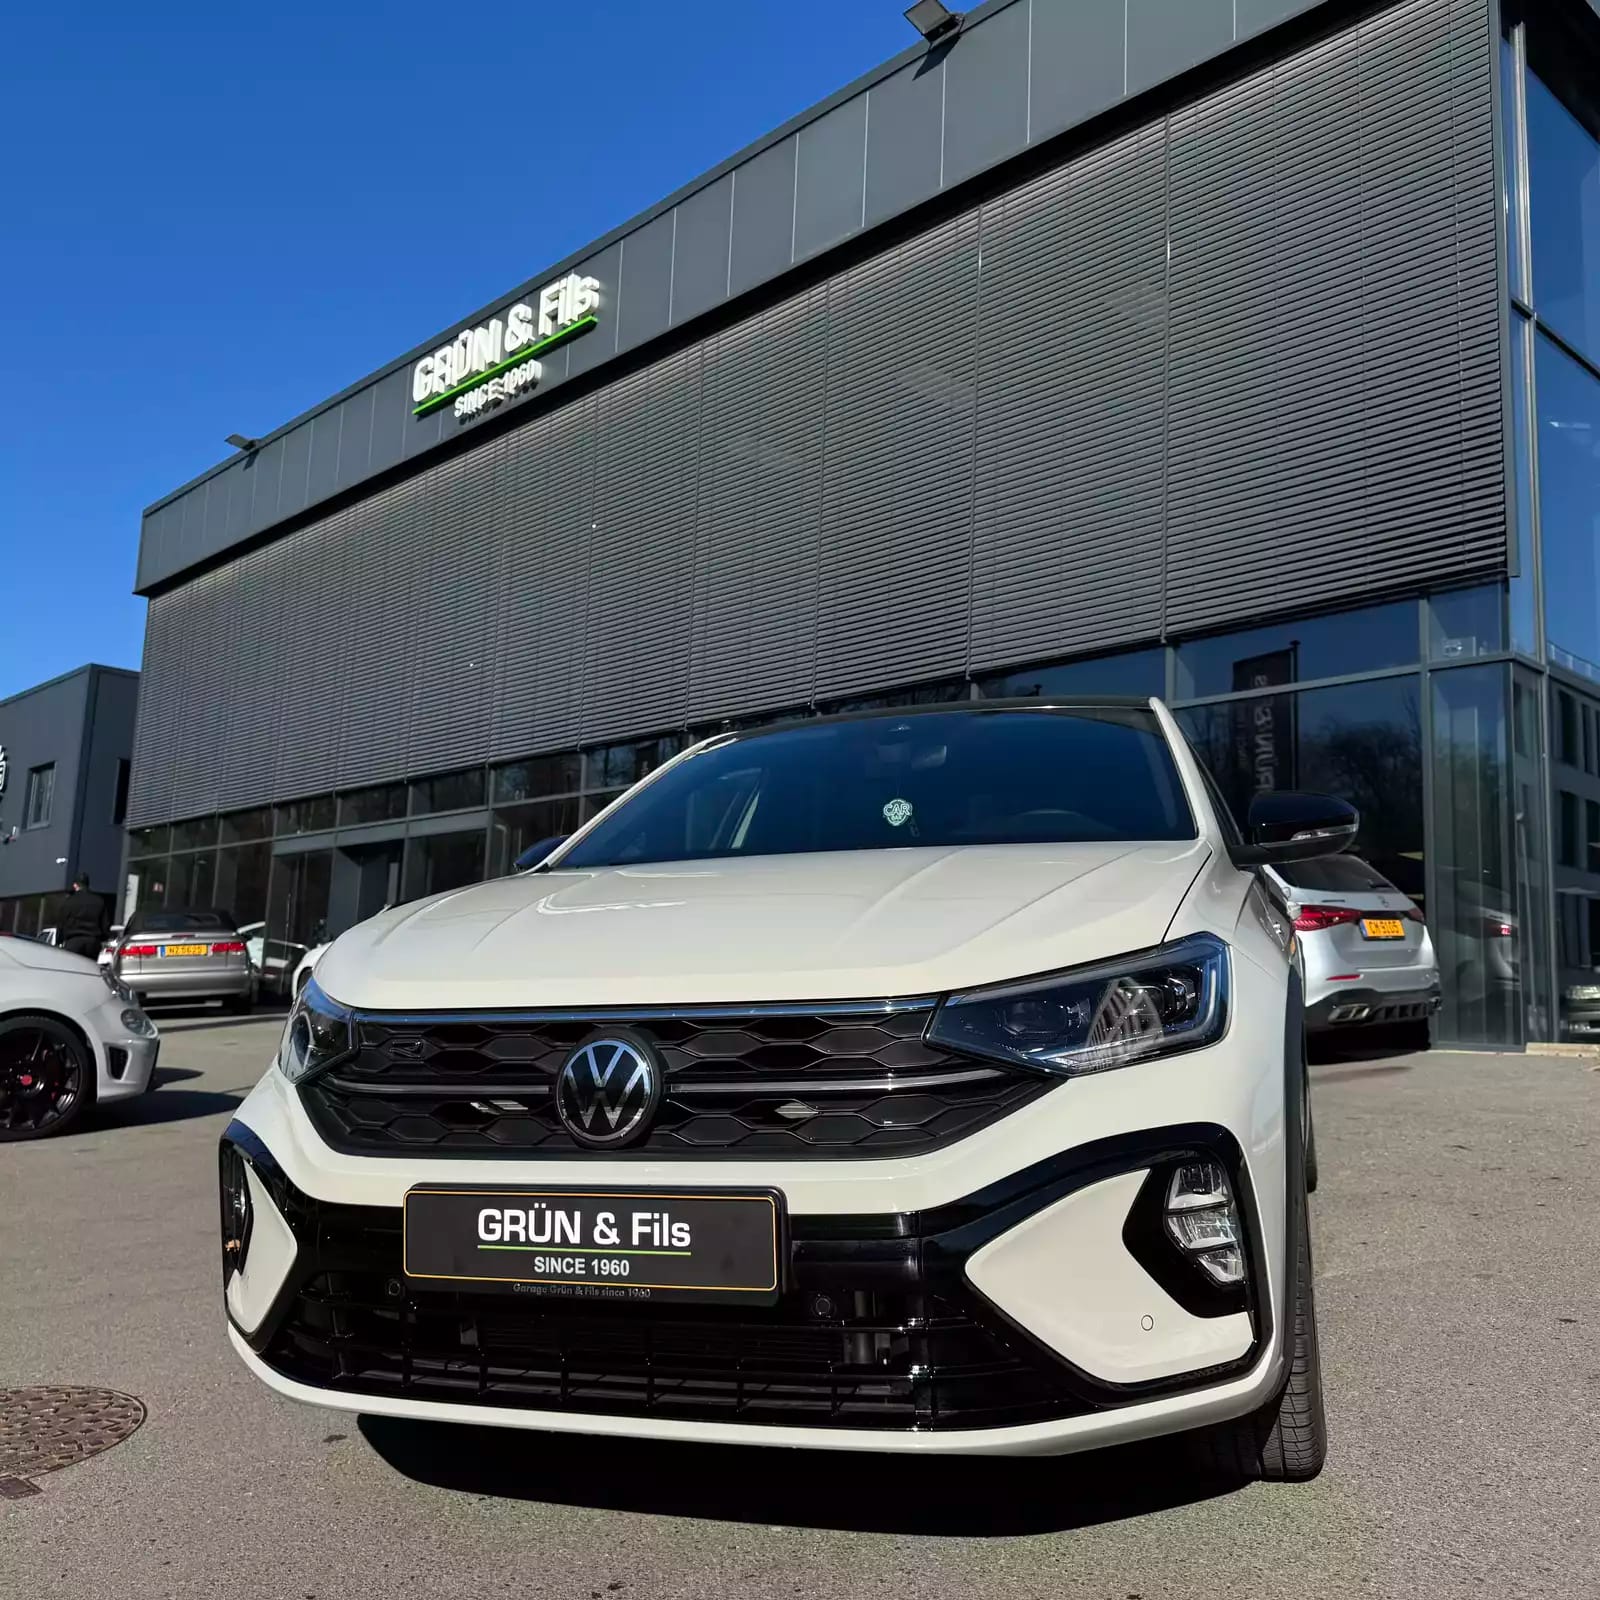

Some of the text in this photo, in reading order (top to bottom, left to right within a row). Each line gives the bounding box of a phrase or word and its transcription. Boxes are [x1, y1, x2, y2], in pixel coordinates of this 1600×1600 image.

[413, 273, 600, 402] GRÜN & Fils
[454, 359, 543, 417] SINCE 1960
[883, 803, 912, 816] CAR
[477, 1203, 691, 1247] GRÜN & Fils
[534, 1256, 630, 1276] SINCE 1960
[513, 1283, 651, 1298] Garage Grün & Fils since 1960
